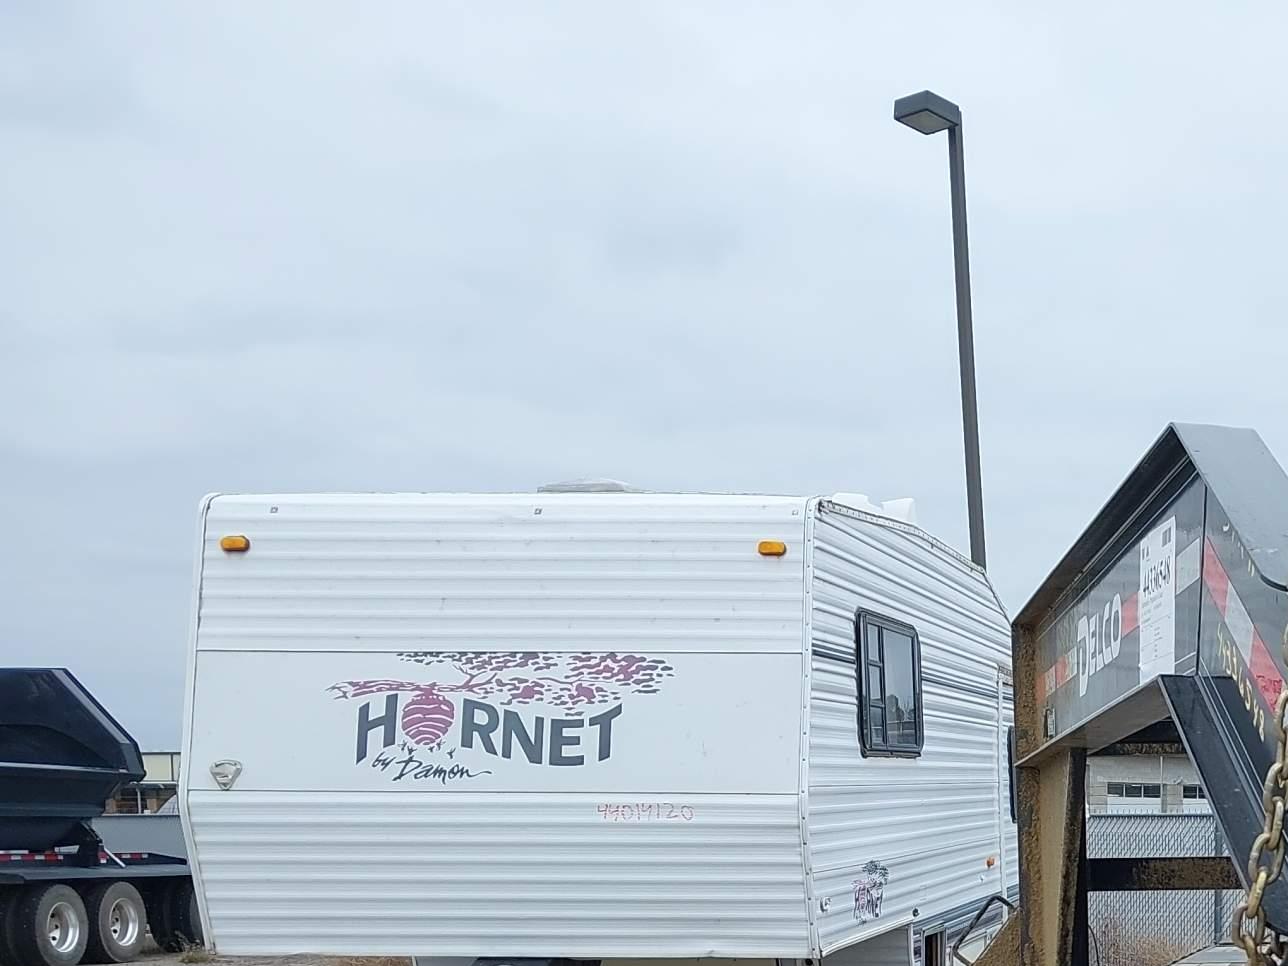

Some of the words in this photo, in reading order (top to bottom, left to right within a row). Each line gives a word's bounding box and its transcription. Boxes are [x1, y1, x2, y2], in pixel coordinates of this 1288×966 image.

[1077, 593, 1122, 697] DELCO
[355, 692, 623, 767] HORNET
[371, 751, 396, 772] by
[391, 755, 493, 785] Damon
[597, 802, 695, 821] 44014120
